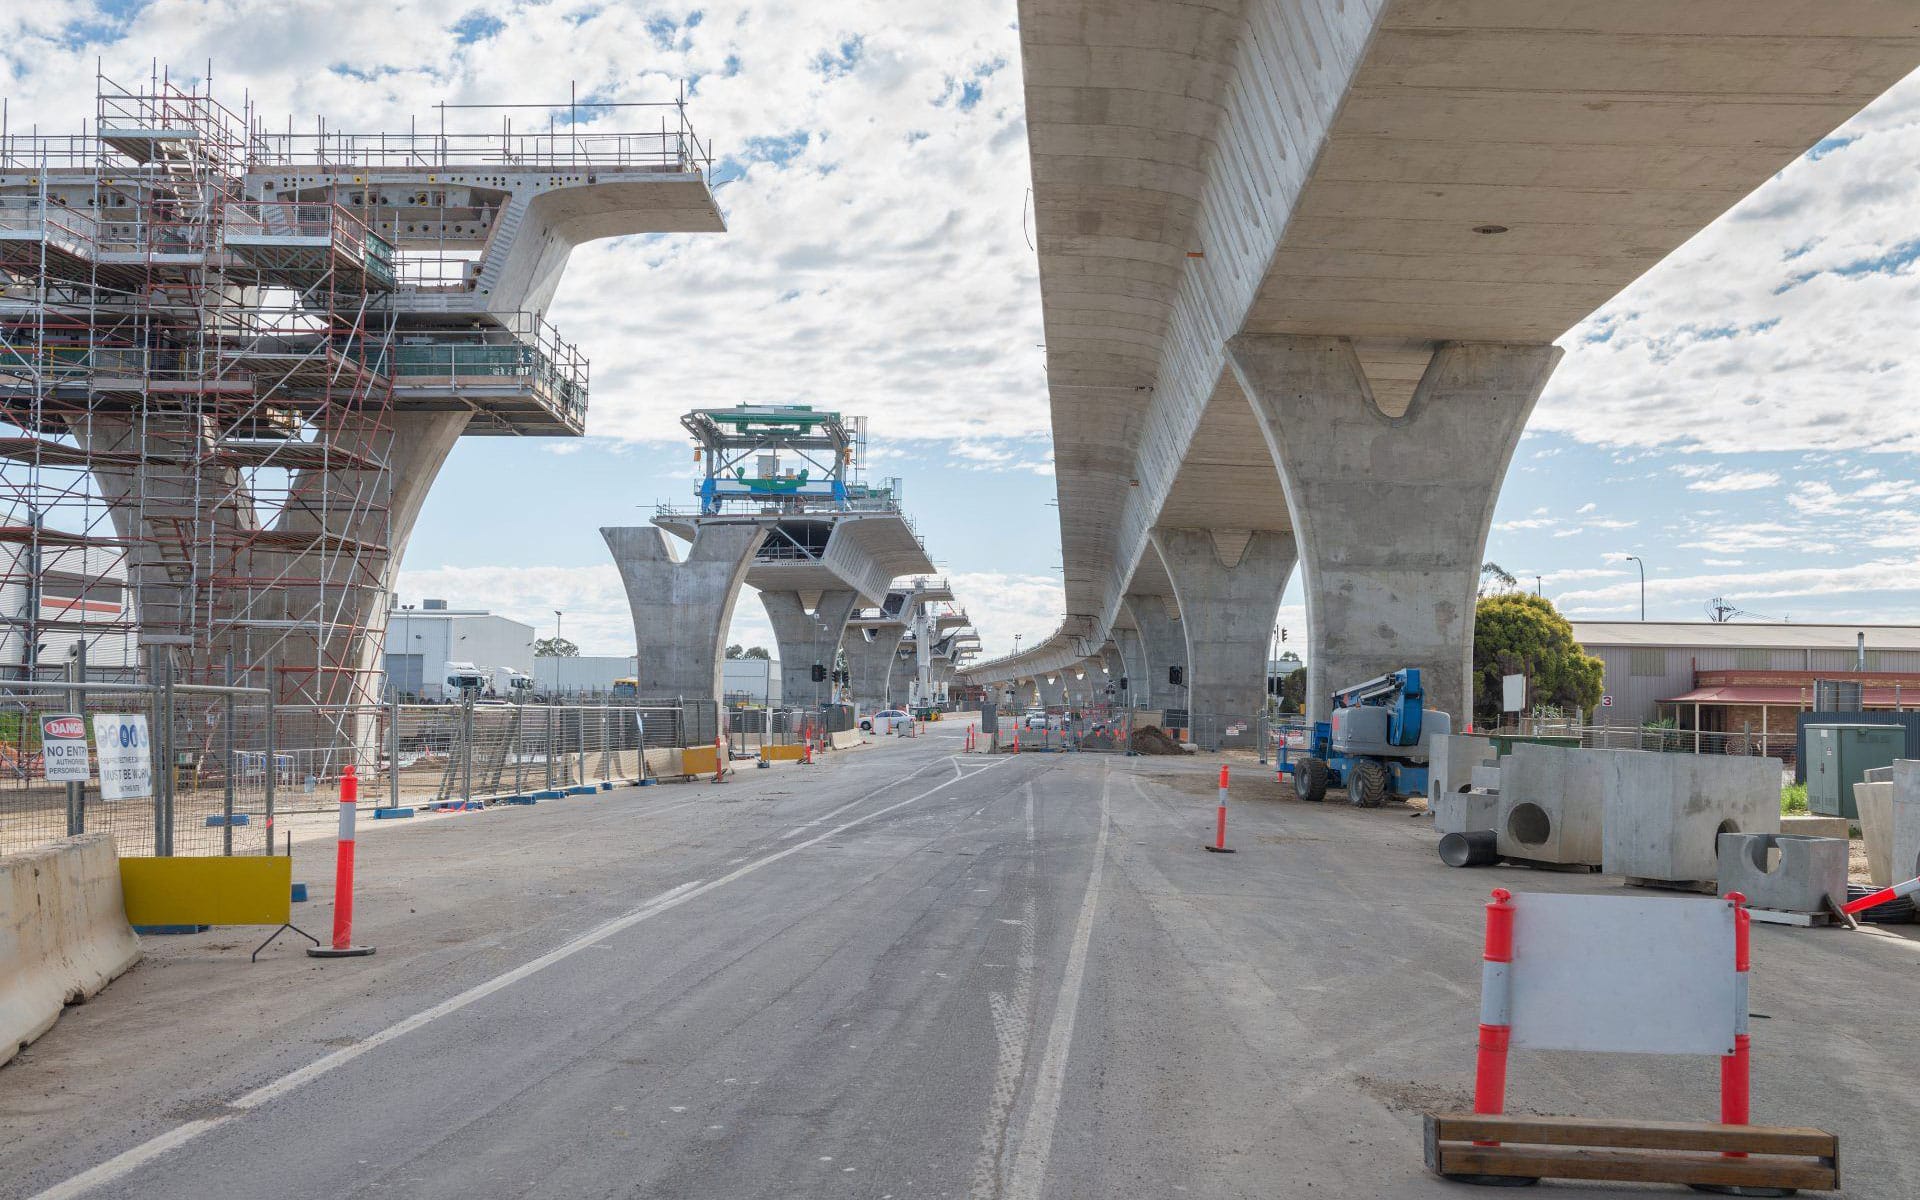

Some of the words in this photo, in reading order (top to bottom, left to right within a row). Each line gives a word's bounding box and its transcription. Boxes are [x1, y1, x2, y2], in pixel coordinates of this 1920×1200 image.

[1603, 696, 1611, 705] 3
[51, 722, 84, 734] DANGE
[47, 746, 64, 757] NO
[103, 769, 122, 781] MUST
[123, 768, 132, 780] BE
[132, 768, 149, 780] WORN
